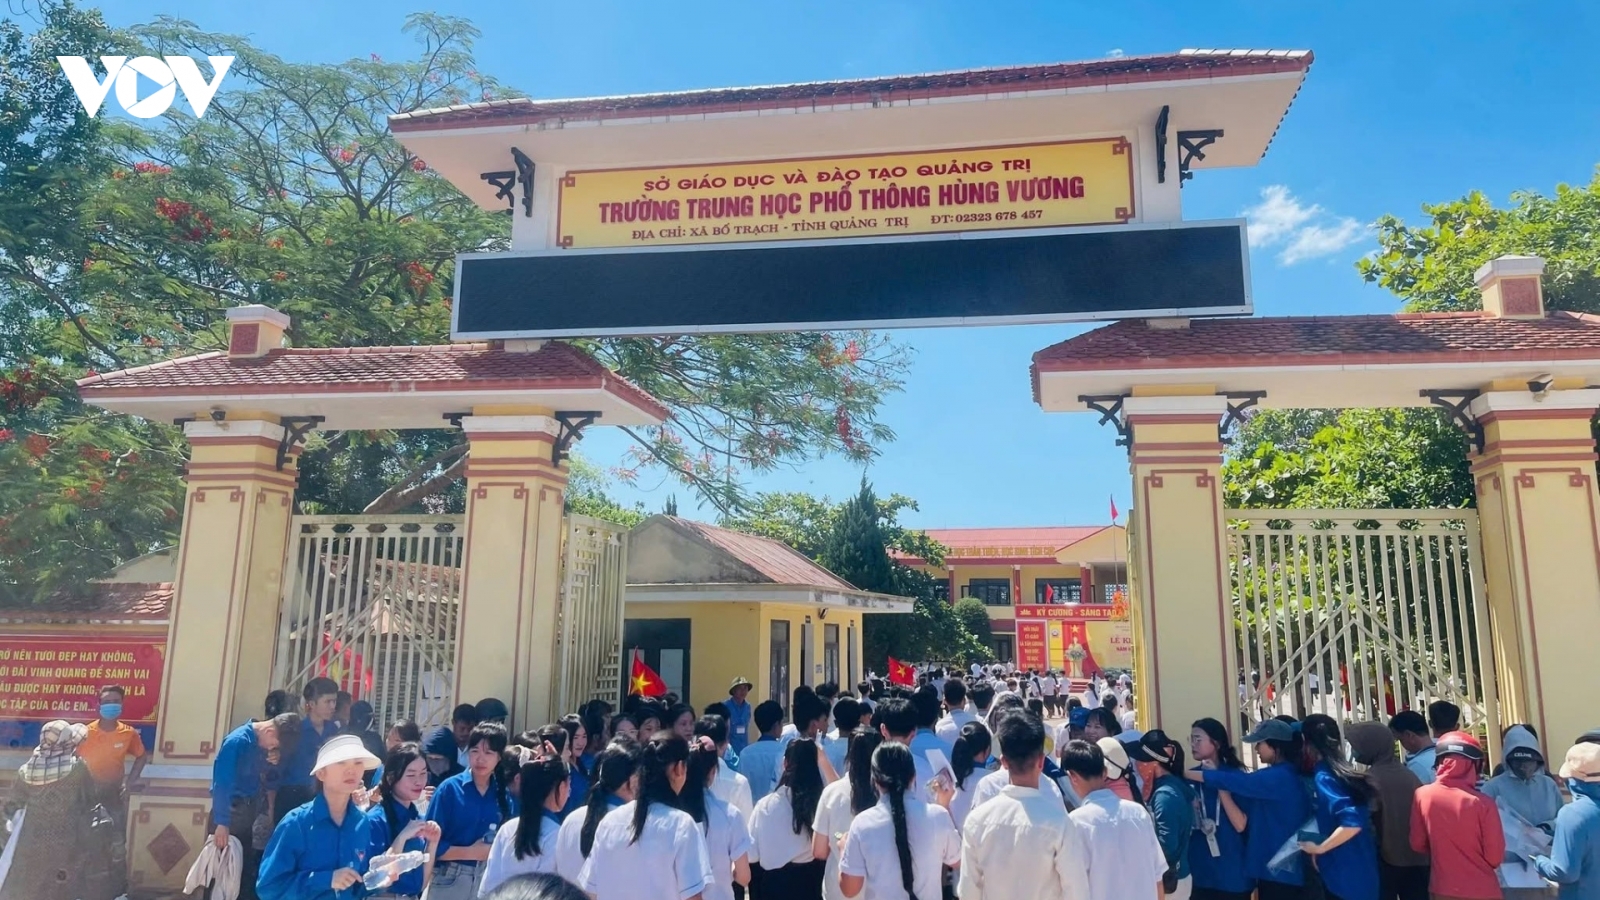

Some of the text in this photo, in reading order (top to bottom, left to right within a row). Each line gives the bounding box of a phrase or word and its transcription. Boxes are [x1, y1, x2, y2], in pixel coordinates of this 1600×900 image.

[643, 158, 1031, 192] SỞ GIÁO DỤC VÀ ĐÀO TẠO QUẢNG TRỊ
[599, 175, 1085, 224] TRƯỜNG TRUNG HỌC PHỔ THÔNG HÙNG VƯƠNG
[631, 229, 655, 241] ĐỊA
[690, 225, 709, 237] XÃ
[712, 223, 731, 236] BỐ
[734, 223, 779, 236] TRẠCH
[792, 218, 827, 233] TỈNH
[829, 215, 878, 231] QUẢNG
[884, 216, 909, 228] TRỊ
[995, 211, 1017, 221] 678
[1021, 209, 1043, 220] 457
[0, 647, 136, 664] RỞ NÊN TƯƠI ĐẸP HAY KHÔNG,
[30, 667, 53, 677] VINH
[55, 667, 87, 678] QUANG
[89, 665, 102, 678] ĐỂ
[105, 667, 131, 679] SÁNH
[134, 669, 150, 679] VAI
[14, 683, 40, 695] ĐƯỢC
[42, 684, 61, 694] HAY
[63, 683, 98, 696] KHÔNG,
[134, 683, 146, 696] LÀ
[10, 697, 28, 712] TẬP
[30, 698, 49, 710] CỦA
[51, 698, 71, 711] CÁC
